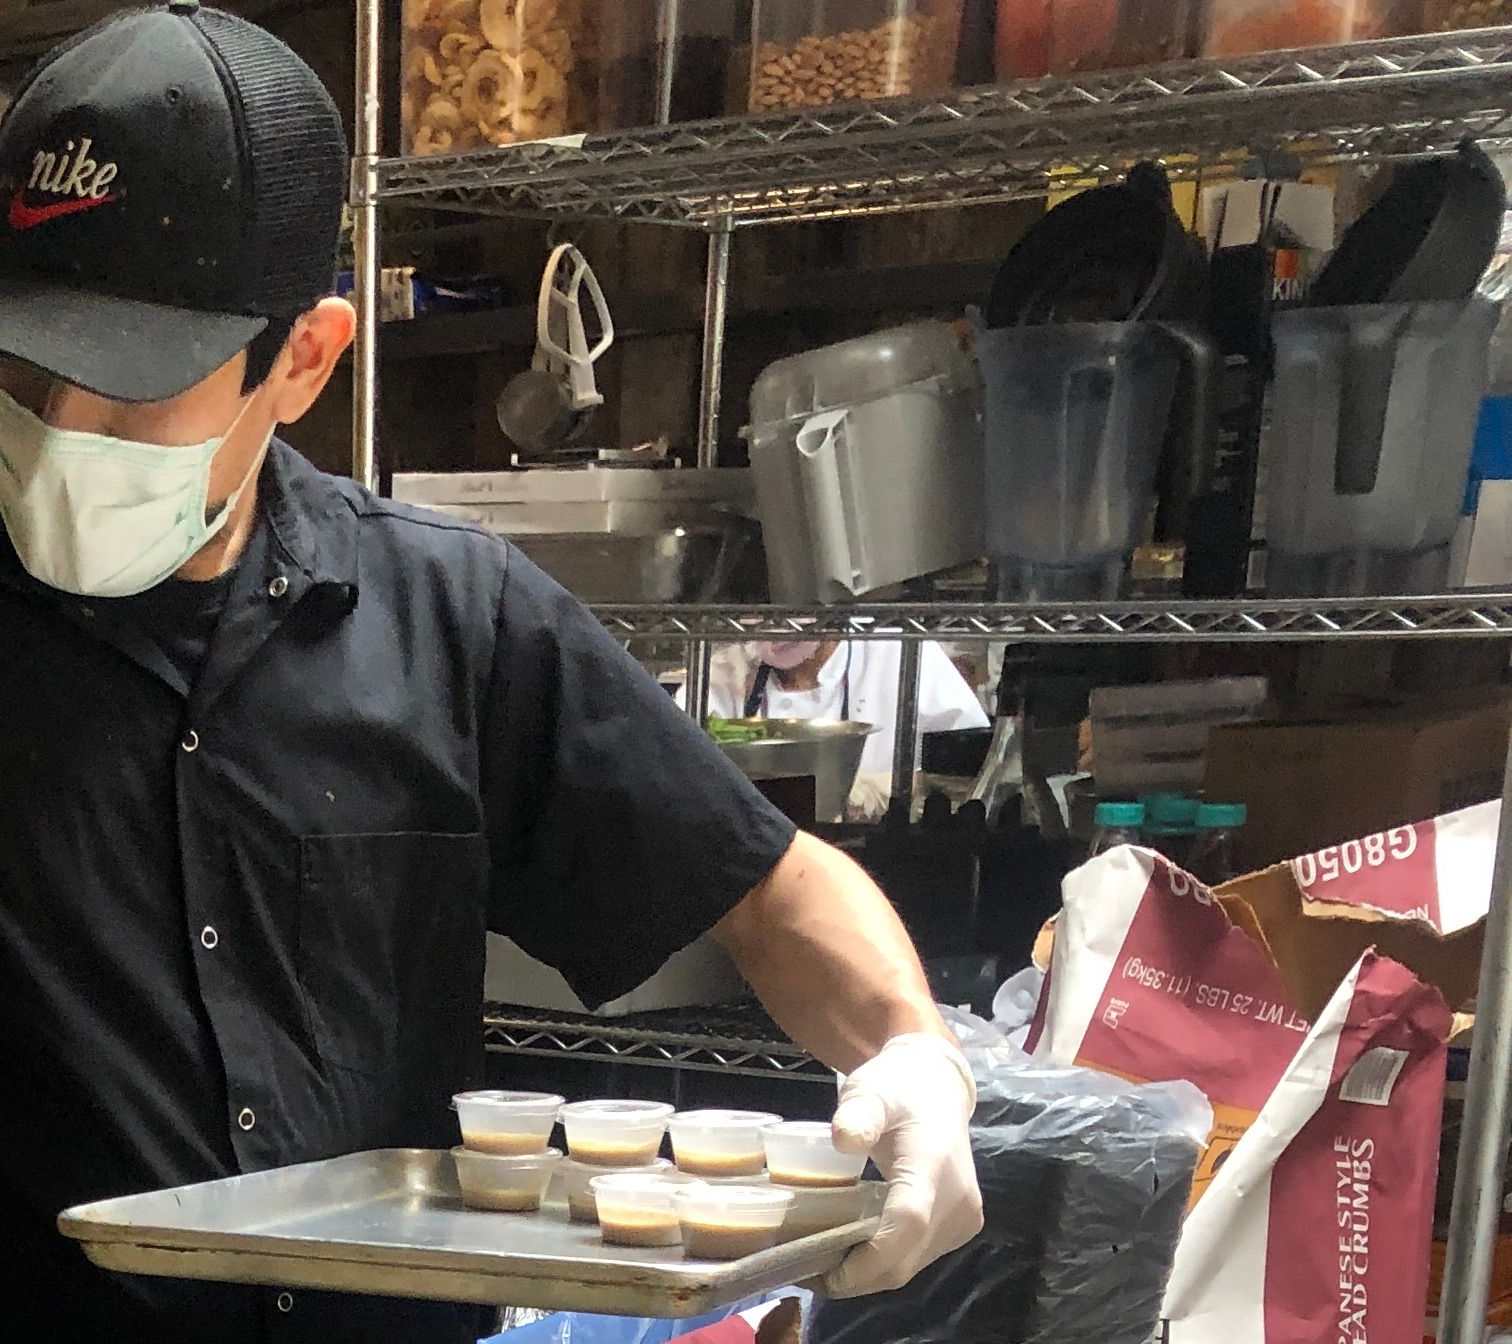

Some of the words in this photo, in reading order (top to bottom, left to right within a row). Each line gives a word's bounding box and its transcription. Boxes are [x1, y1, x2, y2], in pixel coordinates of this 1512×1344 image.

[28, 139, 118, 199] nike
[1296, 825, 1418, 888] G8050
[1122, 956, 1192, 1001] (11.35kg)
[1196, 981, 1231, 1012] LBS.
[1230, 992, 1255, 1016] 25
[1334, 1135, 1352, 1228] STYLE
[1352, 1138, 1374, 1275] CRUMBS
